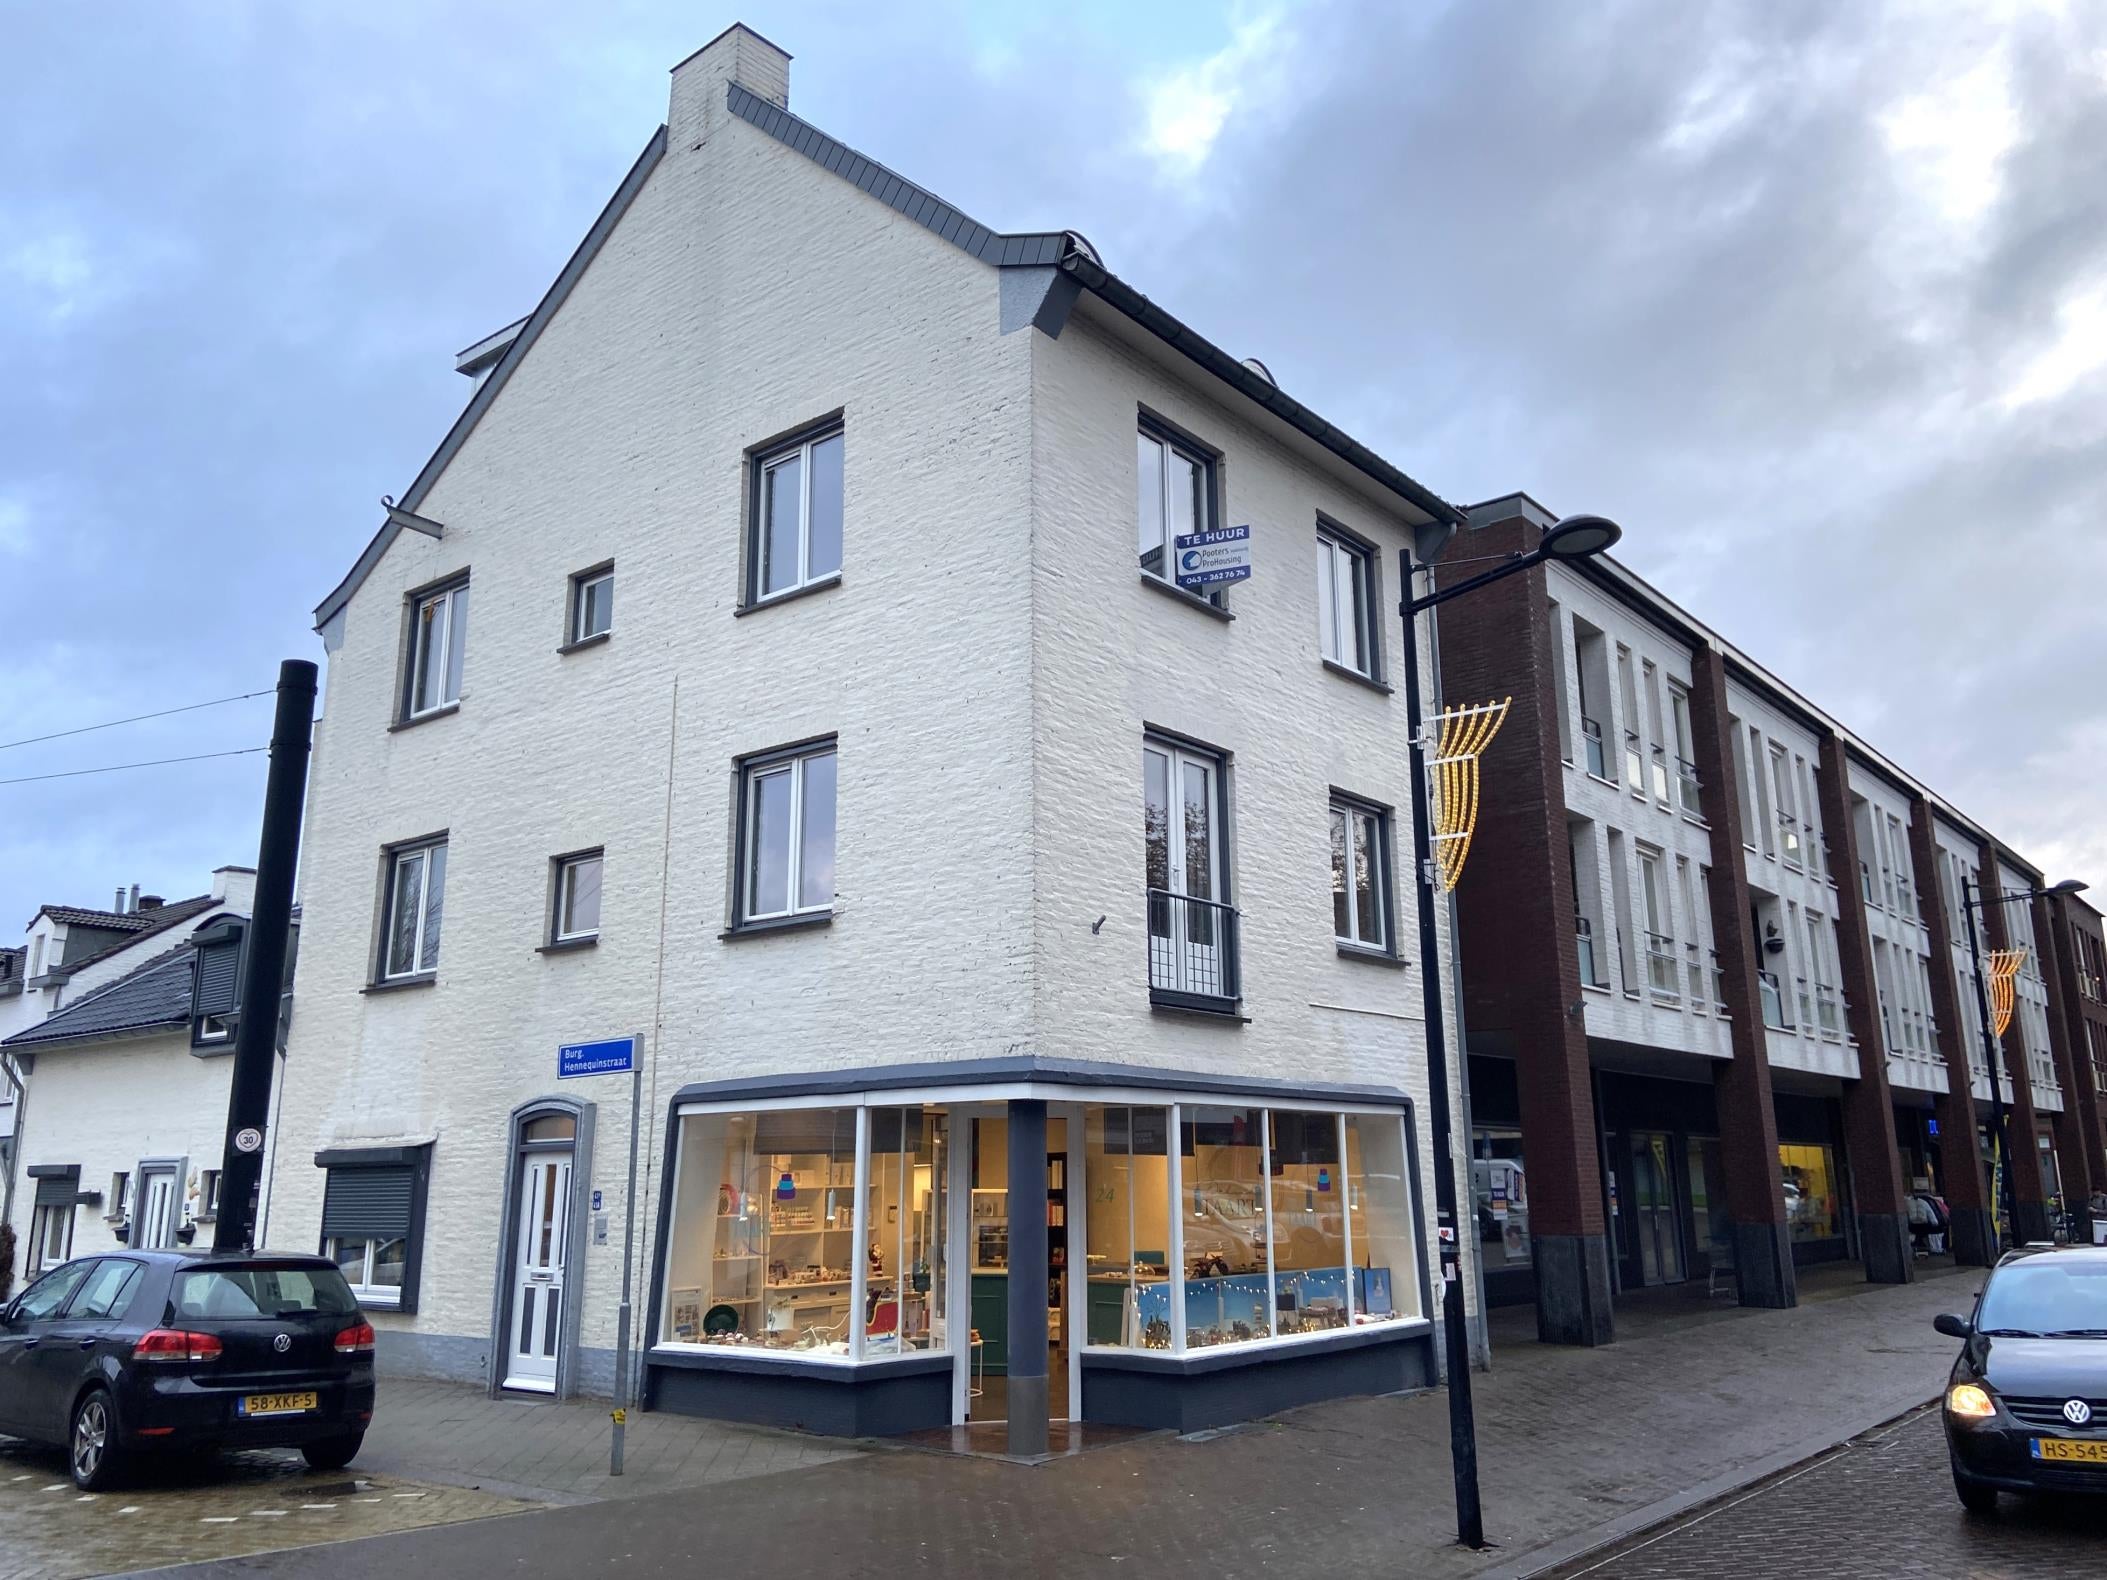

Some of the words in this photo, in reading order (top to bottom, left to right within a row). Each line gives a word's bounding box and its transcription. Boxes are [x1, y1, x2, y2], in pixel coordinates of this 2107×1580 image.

[1184, 534, 1201, 546] TE
[1206, 528, 1245, 542] HUUR
[1202, 548, 1230, 557] Pooters
[1202, 556, 1242, 568] ProHousing
[1186, 576, 1202, 584] 043
[1209, 573, 1224, 581] 362
[1224, 570, 1235, 578] 76
[565, 1049, 585, 1060] Burg.
[564, 1057, 627, 1072] Hennequinstraat
[243, 1136, 254, 1145] 30
[251, 1394, 312, 1410] 58-XKF-5
